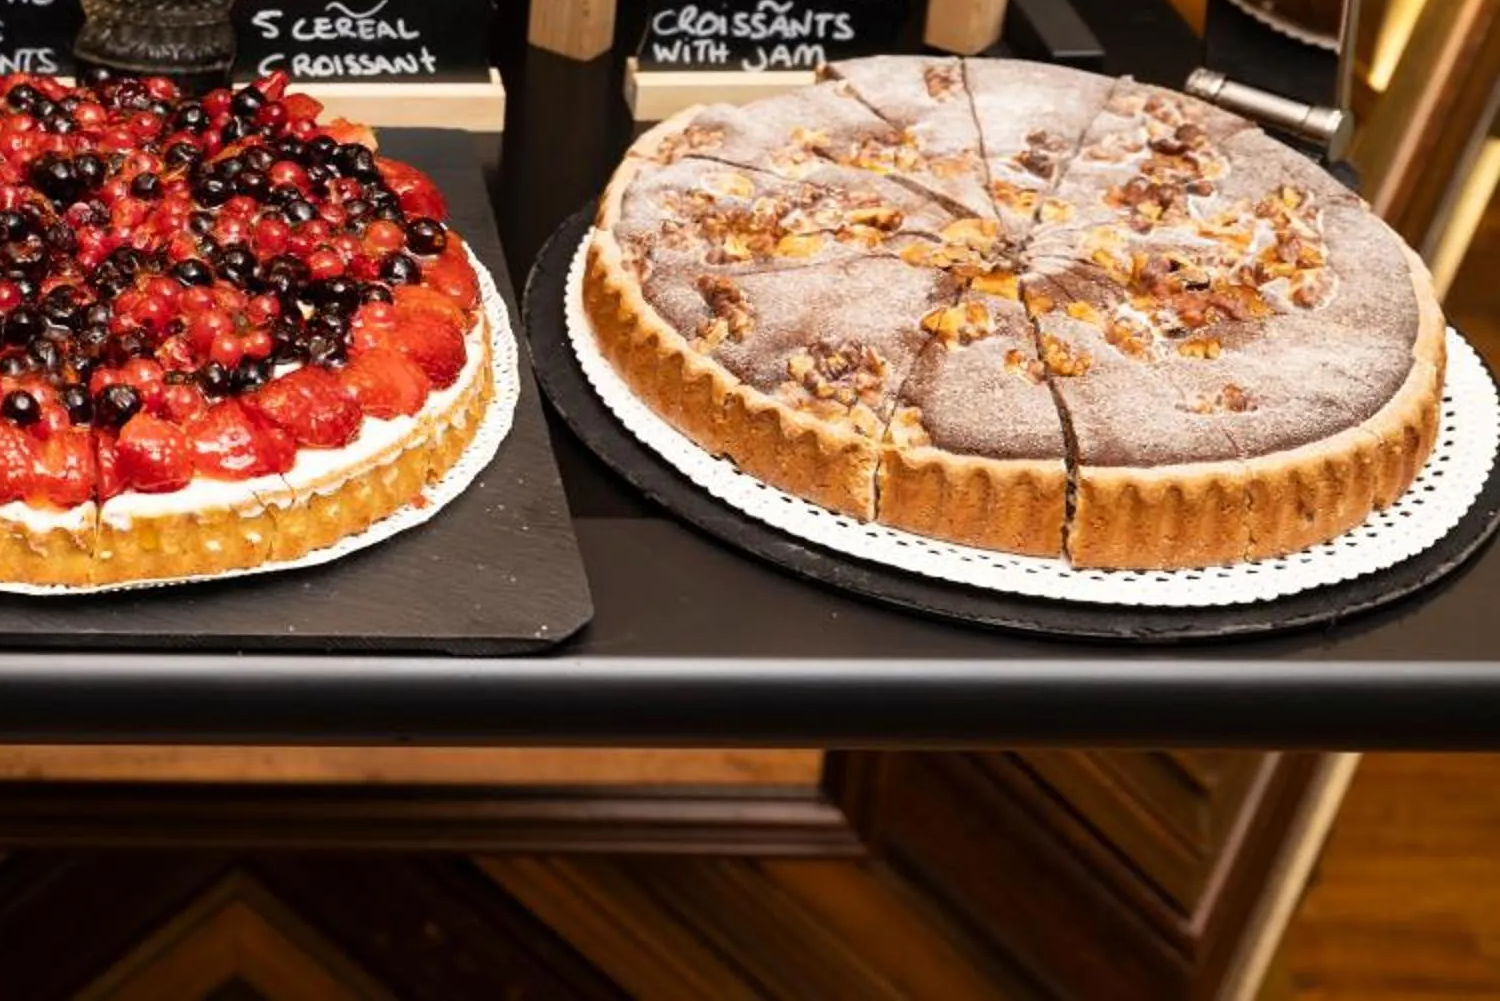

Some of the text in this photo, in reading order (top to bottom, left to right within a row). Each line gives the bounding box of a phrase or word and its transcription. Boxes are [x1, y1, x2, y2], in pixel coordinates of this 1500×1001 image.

[292, 17, 419, 41] CEREAL
[652, 4, 854, 40] CROISSANTS
[742, 45, 826, 72] JAM
